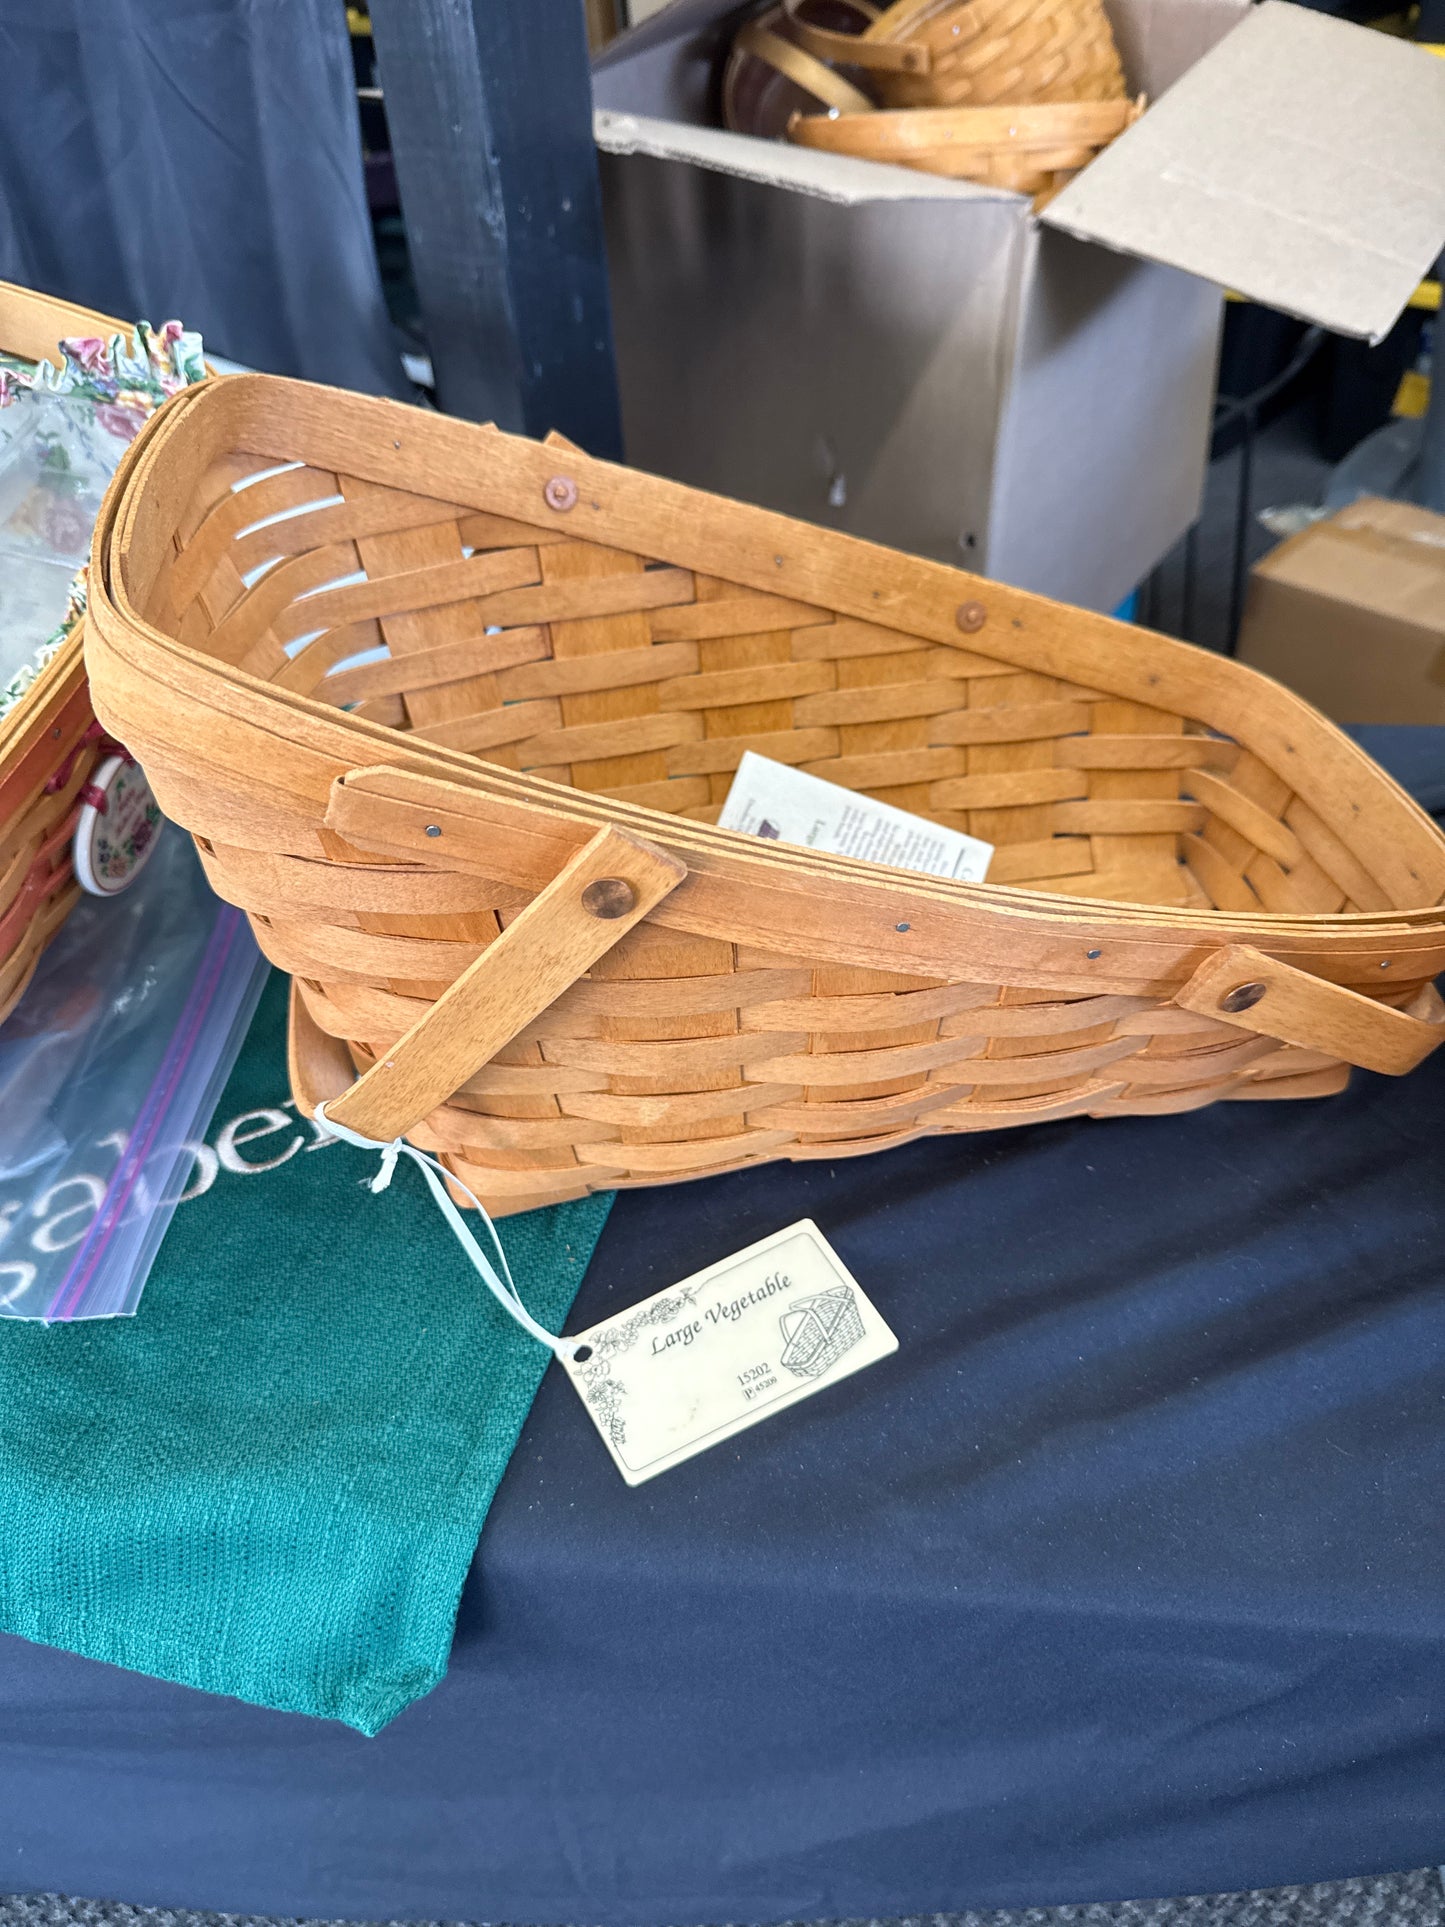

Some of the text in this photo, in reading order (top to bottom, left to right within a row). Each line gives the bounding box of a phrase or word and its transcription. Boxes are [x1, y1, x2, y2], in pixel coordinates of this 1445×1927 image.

[651, 1272, 792, 1356] Large Vegetable
[736, 1362, 772, 1386] 15202
